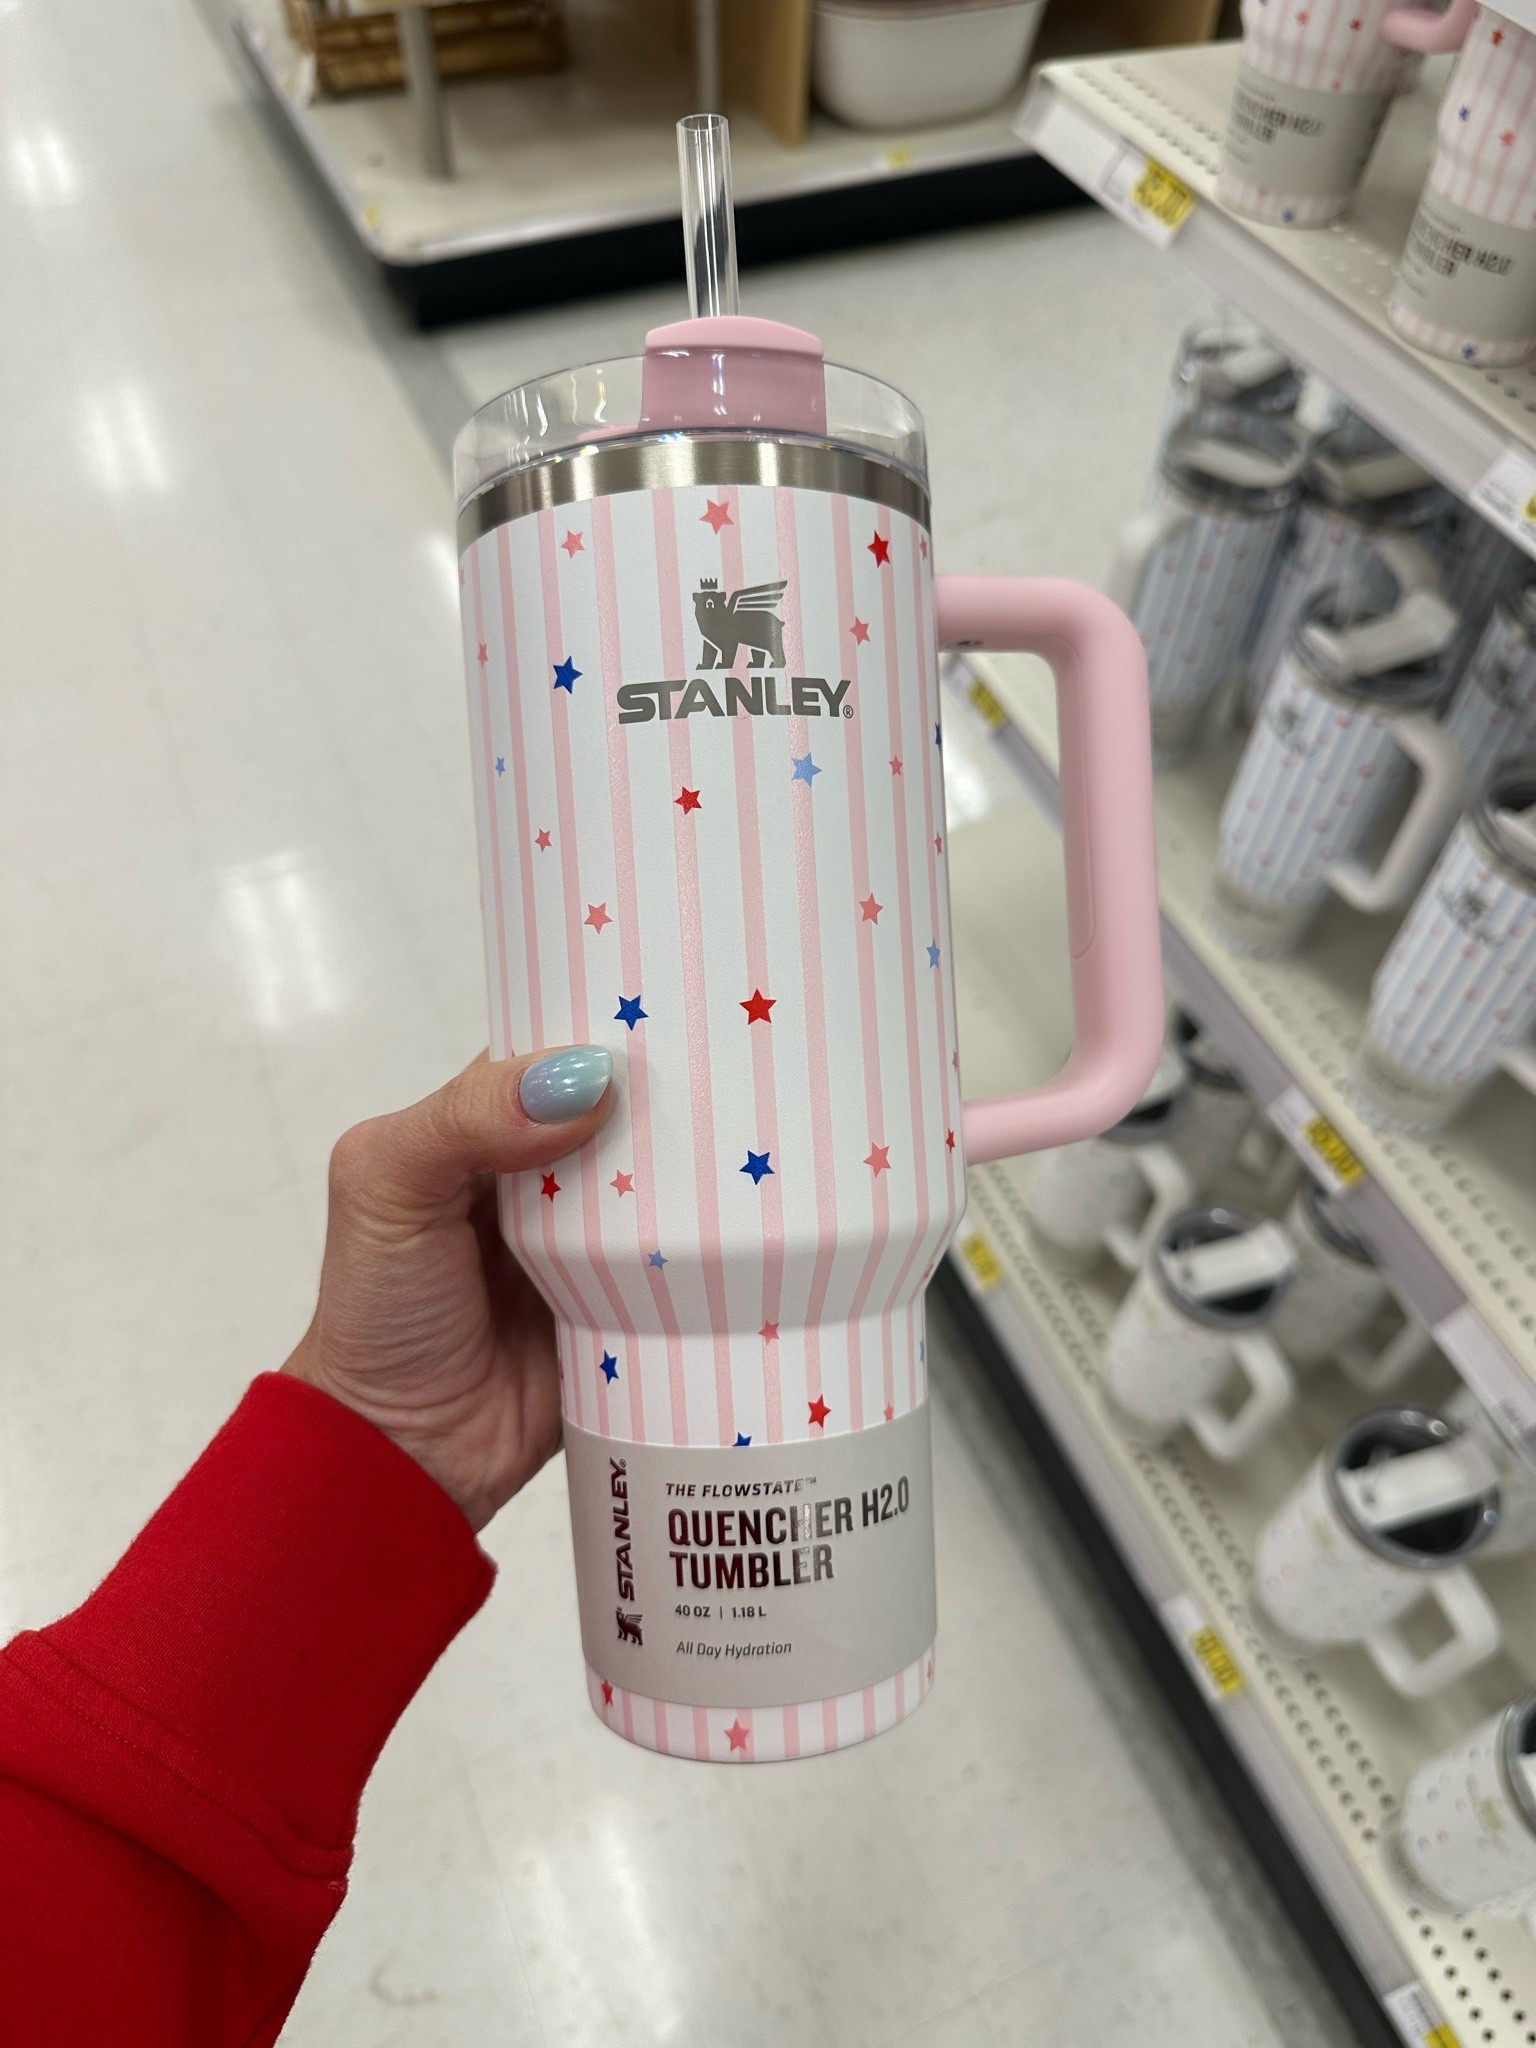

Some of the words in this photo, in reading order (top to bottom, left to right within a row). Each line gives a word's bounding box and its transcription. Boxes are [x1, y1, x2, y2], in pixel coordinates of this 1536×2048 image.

[665, 1482, 697, 1497] THE
[668, 1496, 853, 1547] QUENCHER
[862, 1475, 909, 1527] H2.0
[669, 1543, 834, 1590] TUMBLER
[674, 1603, 691, 1617] 40
[693, 1605, 711, 1618] OZ
[731, 1605, 755, 1618] 1.18
[758, 1605, 767, 1617] L
[676, 1641, 694, 1654] All
[696, 1642, 721, 1659] Day
[725, 1641, 792, 1659] Hydration
